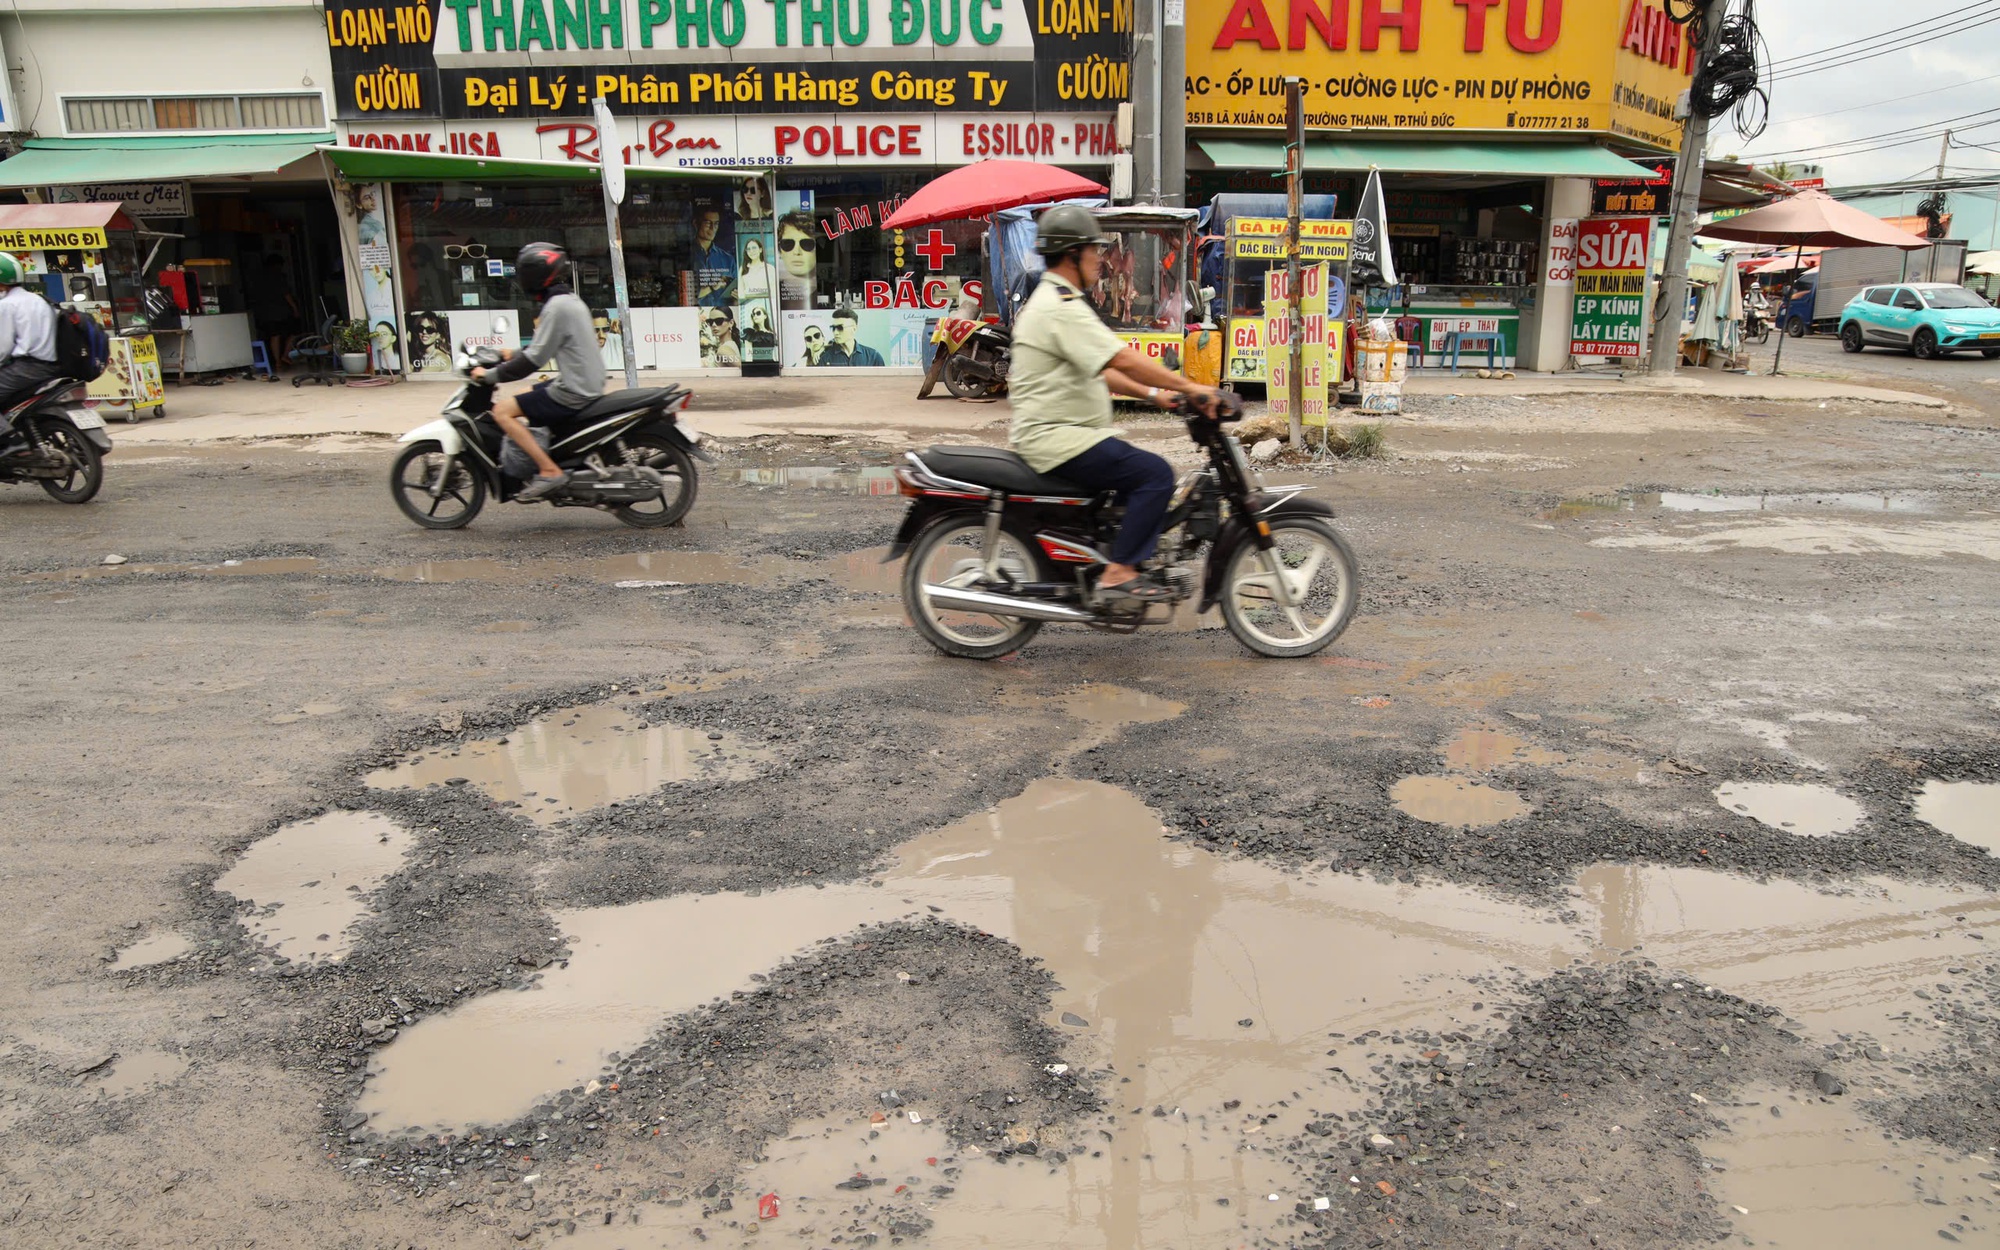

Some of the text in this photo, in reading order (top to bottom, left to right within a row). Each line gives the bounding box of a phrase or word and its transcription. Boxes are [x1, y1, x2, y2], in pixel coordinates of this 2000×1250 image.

[446, 0, 624, 51] THANH
[1212, 0, 1421, 51] ANH
[355, 64, 421, 111] CƯỜM
[1057, 54, 1128, 100] CƯỜM
[1227, 68, 1254, 95] ỐP
[1259, 75, 1309, 96] LƯG
[1325, 72, 1397, 98] CƯỜNG
[1403, 76, 1439, 103] LỰC
[1455, 80, 1485, 99] PIN
[1490, 78, 1518, 104] DỰ
[1522, 74, 1591, 100] PHÒNG
[464, 77, 519, 113] Đại
[529, 75, 567, 110] Lý
[596, 74, 679, 104] Phân
[690, 67, 763, 103] Phối
[774, 71, 859, 106] Hàng
[871, 70, 956, 106] Công
[968, 71, 1008, 106] Ty
[1187, 112, 1213, 124] 351B
[1217, 109, 1230, 124] LÃ
[1234, 110, 1265, 125] XUÂN
[1304, 111, 1348, 126] TRƯỜNG
[1351, 114, 1391, 130] THẠNH,
[1394, 111, 1428, 127] TP.THỦ
[1431, 112, 1455, 127] ĐỨC
[1518, 116, 1589, 129] 077777 21 38
[774, 125, 922, 157] POLICE
[963, 123, 1055, 156] ESSILOR
[1074, 115, 1124, 156] PHÁ
[703, 157, 736, 167] 0908
[739, 157, 755, 166] 45
[757, 157, 775, 166] 89
[777, 156, 793, 165] 82
[83, 185, 180, 204] Yaourt Mật
[821, 206, 873, 241] LÀM
[1240, 222, 1348, 236] GÀ HP MÍA
[29, 233, 79, 247] MANG
[82, 232, 100, 246] ĐI
[1239, 242, 1260, 256] ĐẶC
[1262, 244, 1283, 257] BIỆT
[1317, 245, 1345, 256] NGON
[1578, 222, 1645, 268] SỬA
[864, 271, 949, 310] BÁC
[1577, 271, 1645, 293] THAY MÀN HÌNH
[1577, 297, 1640, 315] ÉP KÍNH
[1234, 325, 1257, 348] GÀ
[1268, 308, 1289, 346] CỦ
[1433, 320, 1448, 333] RÚT
[1478, 320, 1497, 331] THAY
[1573, 319, 1640, 342] LẤY LIỀN
[466, 337, 504, 346] GUESS
[644, 334, 683, 343] GUESS
[1586, 344, 1595, 353] 07
[1597, 344, 1616, 354] 7777
[1617, 345, 1637, 355] 2138
[413, 359, 447, 368] GUESS
[1303, 399, 1323, 415] 8812
